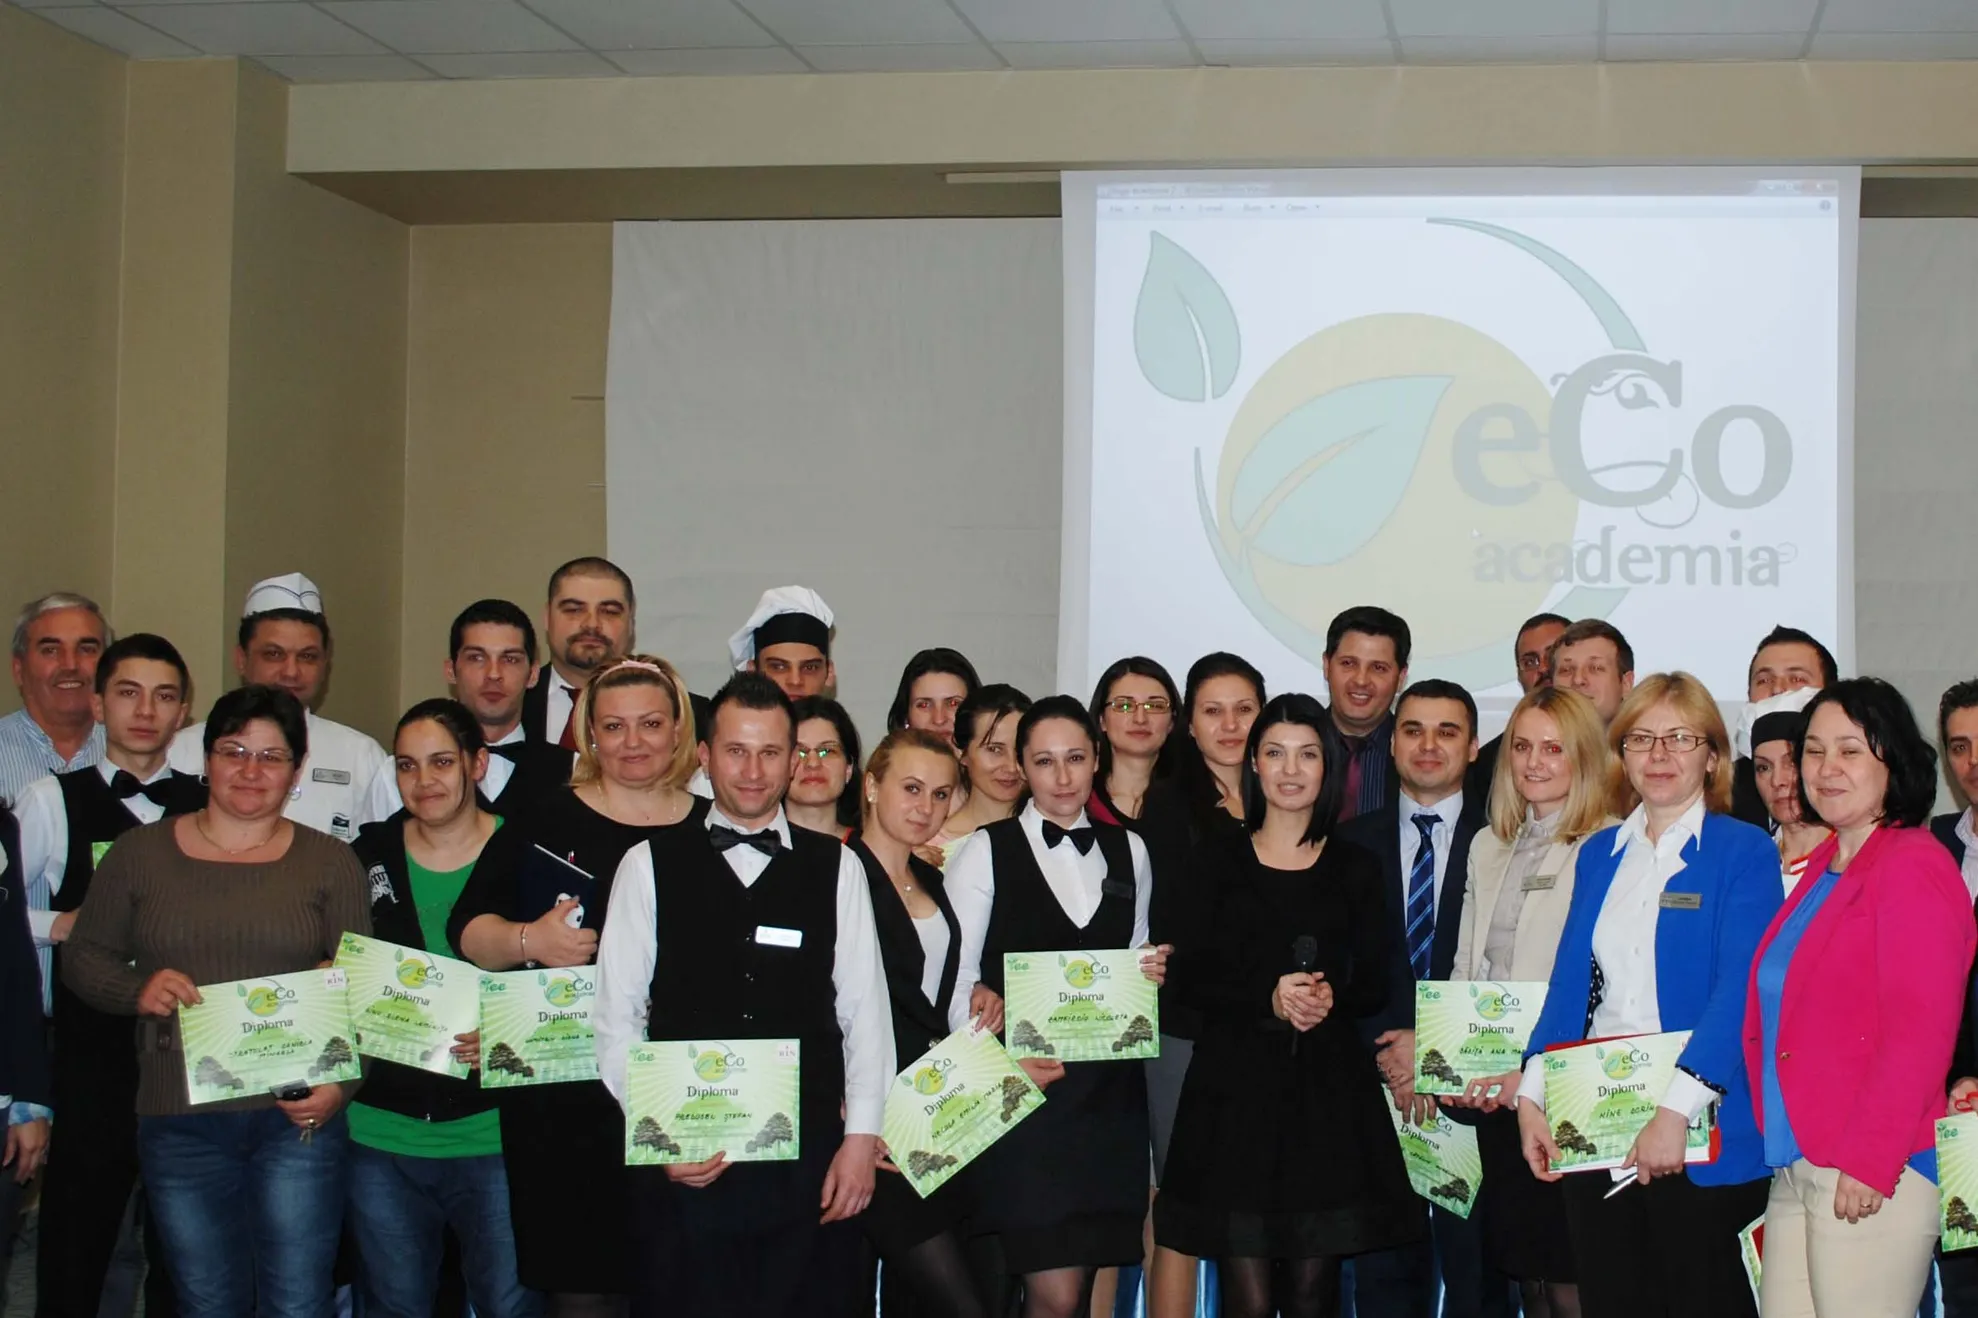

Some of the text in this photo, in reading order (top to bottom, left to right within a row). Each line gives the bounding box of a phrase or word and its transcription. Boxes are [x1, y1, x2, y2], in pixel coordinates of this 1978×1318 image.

[1451, 352, 1794, 510] eCo
[1472, 524, 1780, 588] academia
[416, 965, 444, 981] eCo
[1083, 961, 1109, 976] eCo
[564, 978, 594, 993] eCo
[265, 986, 296, 1002] eCo
[382, 984, 431, 1007] Diploma
[1058, 991, 1105, 1006] Diploma
[1493, 993, 1520, 1007] eCo
[538, 1010, 588, 1025] Diploma
[241, 1018, 294, 1035] Diploma
[1468, 1022, 1515, 1037] Diploma
[715, 1052, 745, 1068] eCo
[1621, 1049, 1650, 1064] eCo
[928, 1057, 953, 1078] eCo
[687, 1085, 739, 1100] Diploma
[1598, 1082, 1647, 1099] Diploma
[923, 1082, 966, 1117] Diploma
[1400, 1123, 1440, 1151] Diploma
